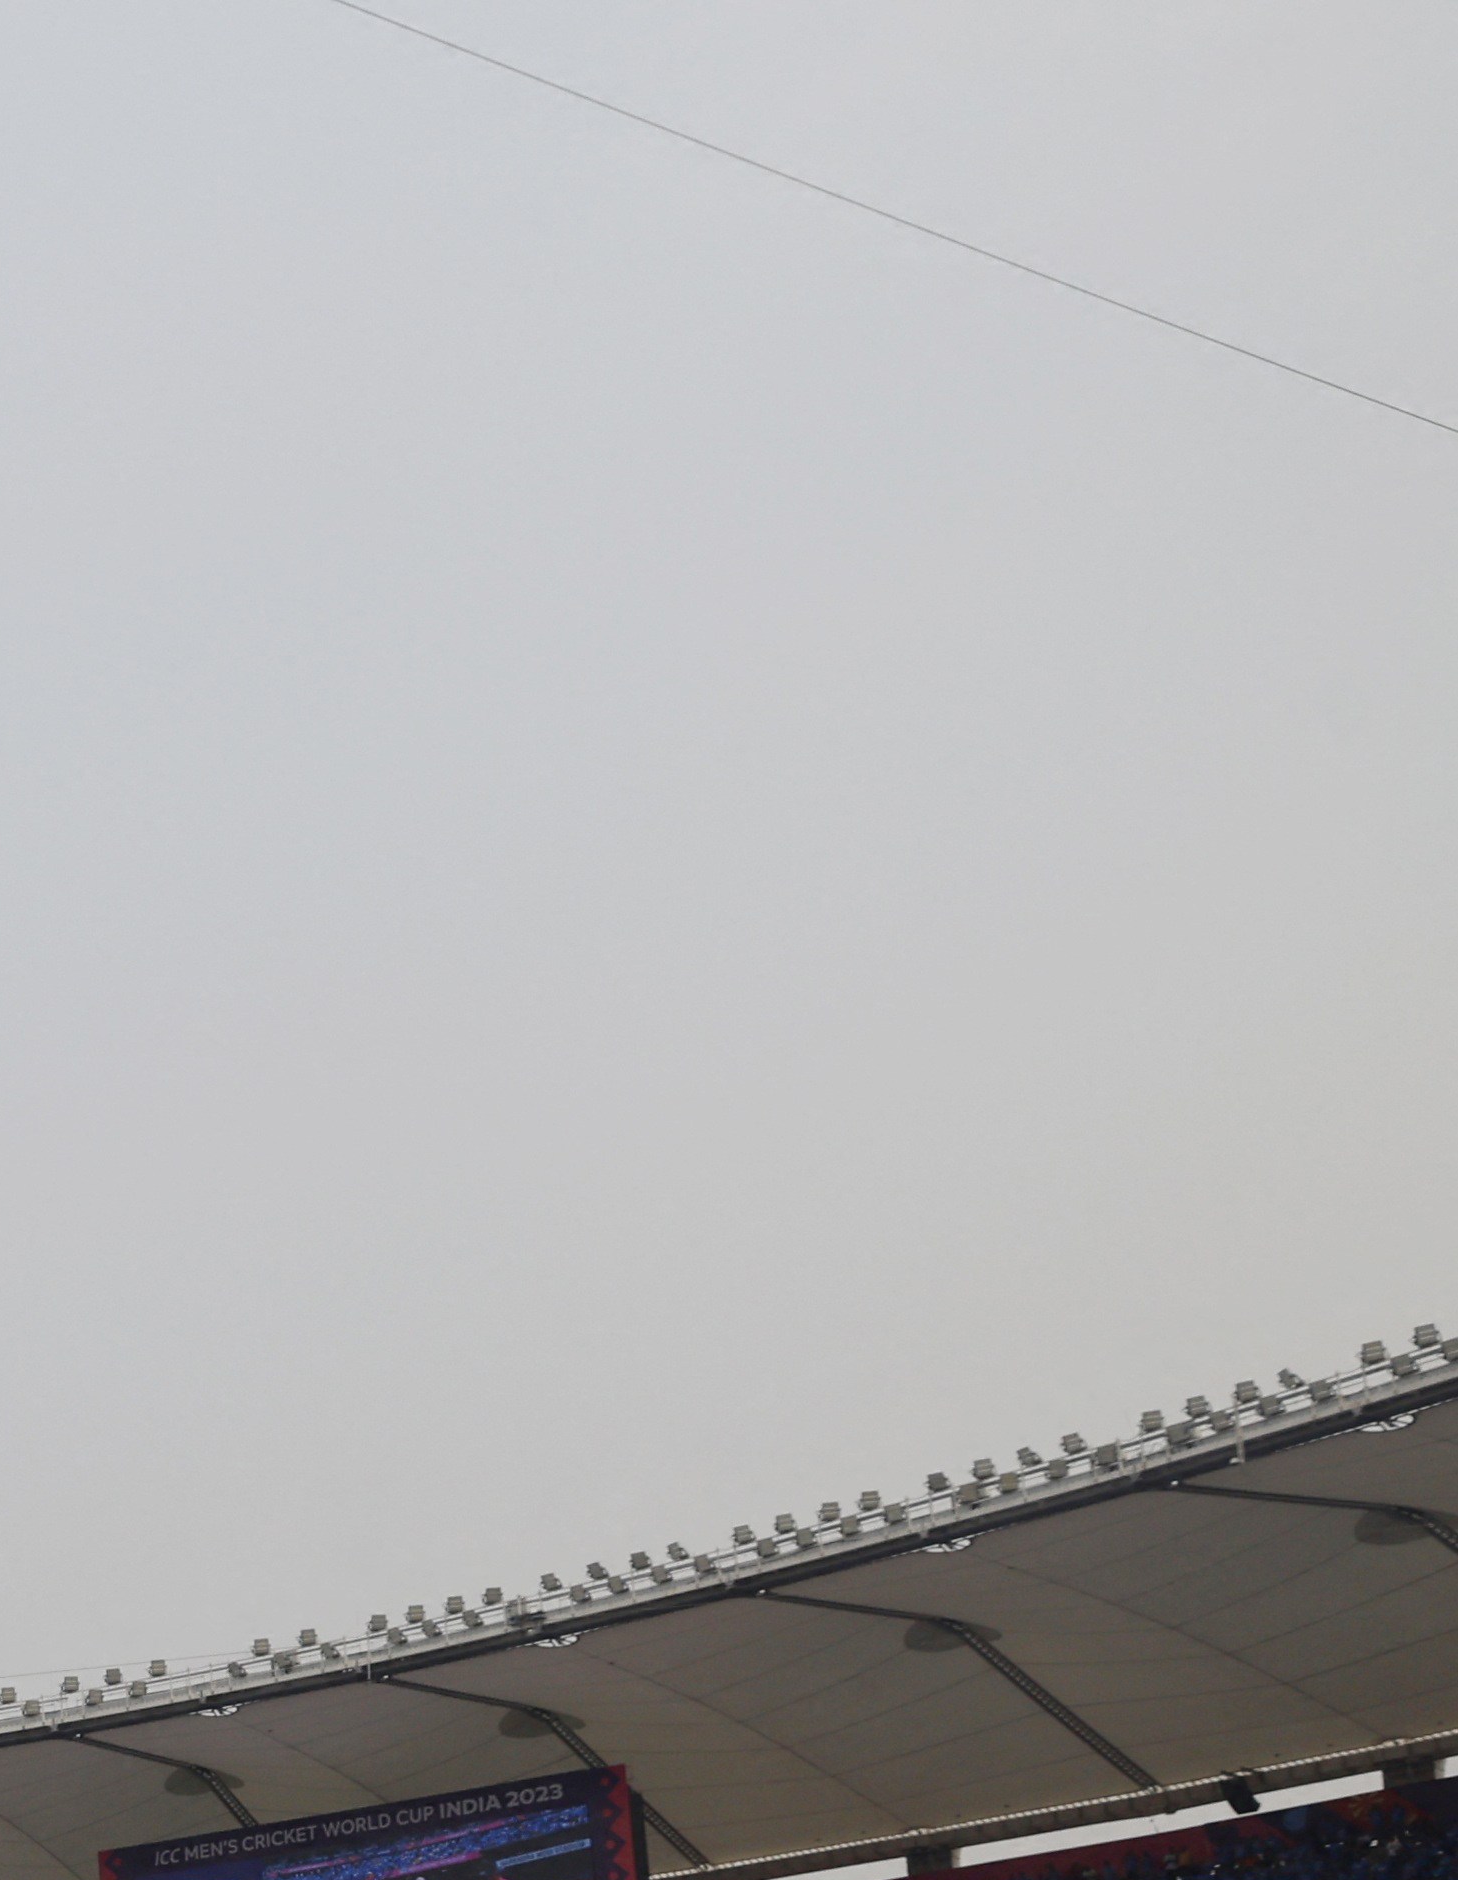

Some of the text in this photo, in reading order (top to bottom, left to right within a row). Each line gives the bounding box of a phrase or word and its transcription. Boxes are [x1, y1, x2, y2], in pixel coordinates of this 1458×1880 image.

[154, 1783, 563, 1866] ICC MEN'S CRICKET WORLD CUP INDIA 2023
